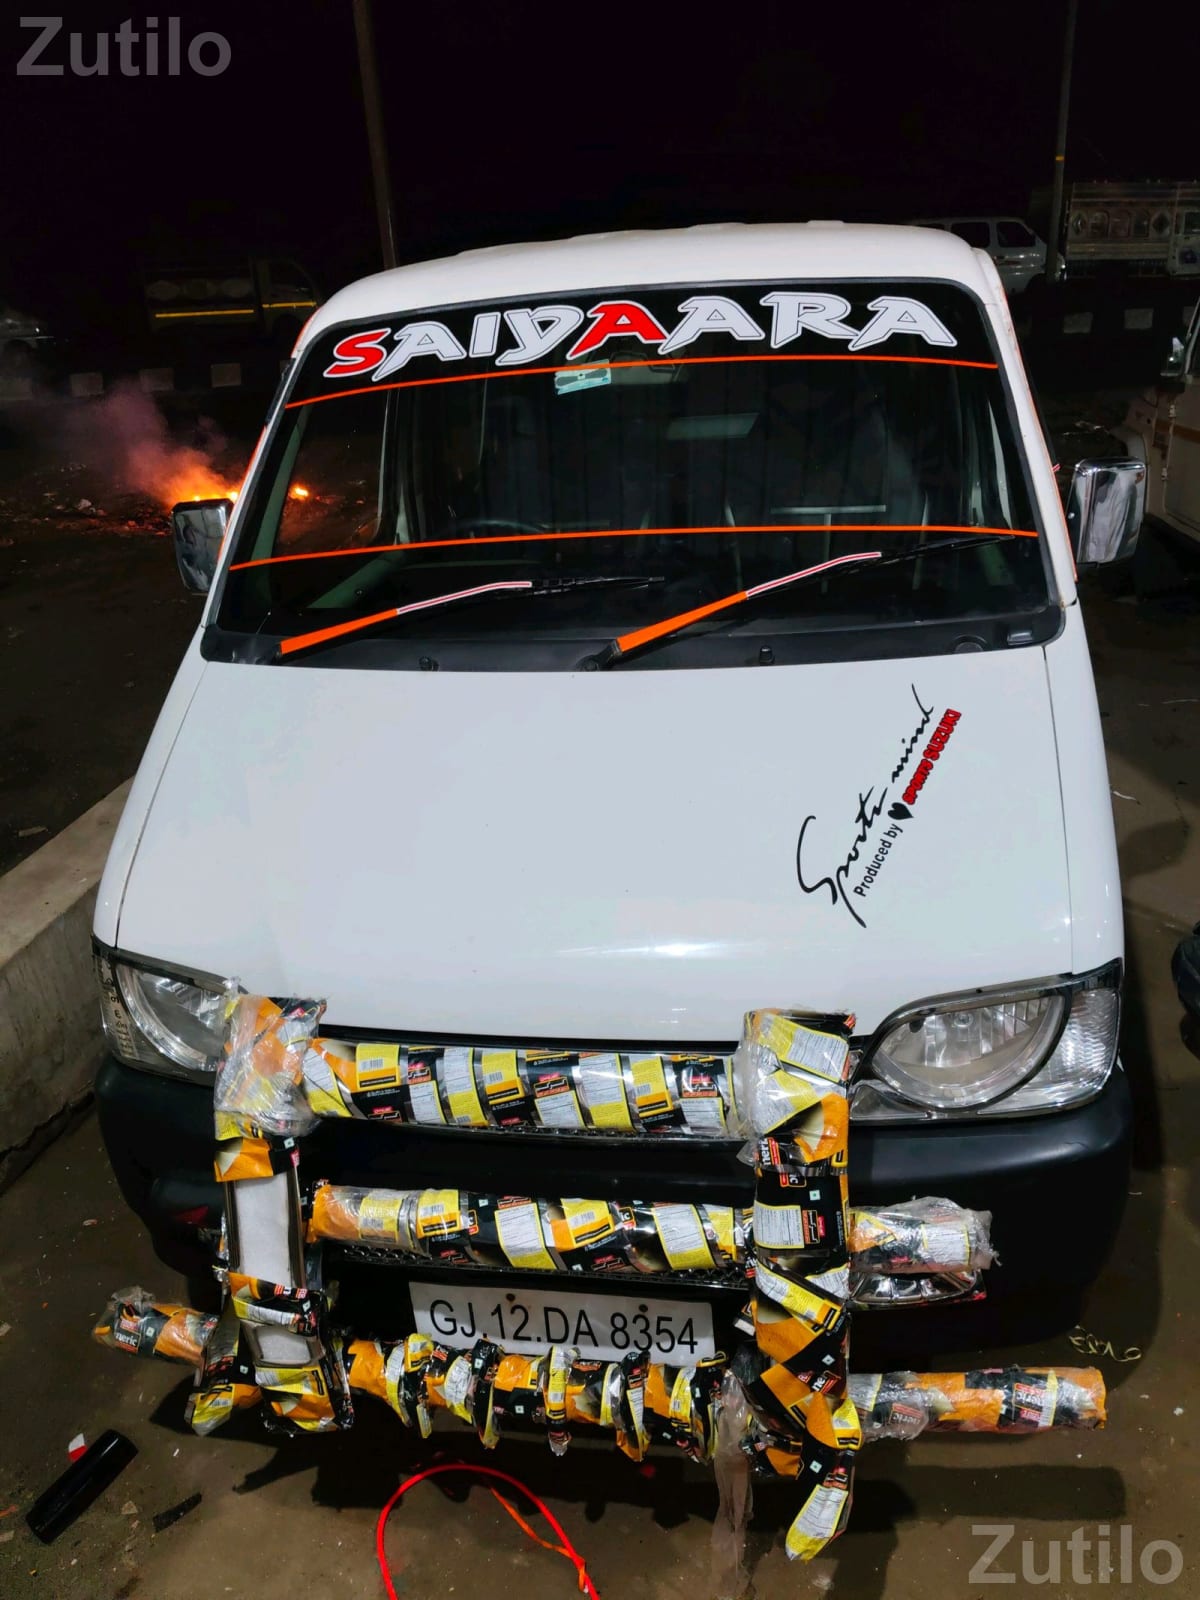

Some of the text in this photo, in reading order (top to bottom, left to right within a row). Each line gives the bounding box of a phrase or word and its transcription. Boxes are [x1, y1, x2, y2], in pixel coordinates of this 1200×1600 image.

[853, 708, 962, 897] Produced by SPORTS SUZUKI
[610, 1312, 699, 1355] 8354
